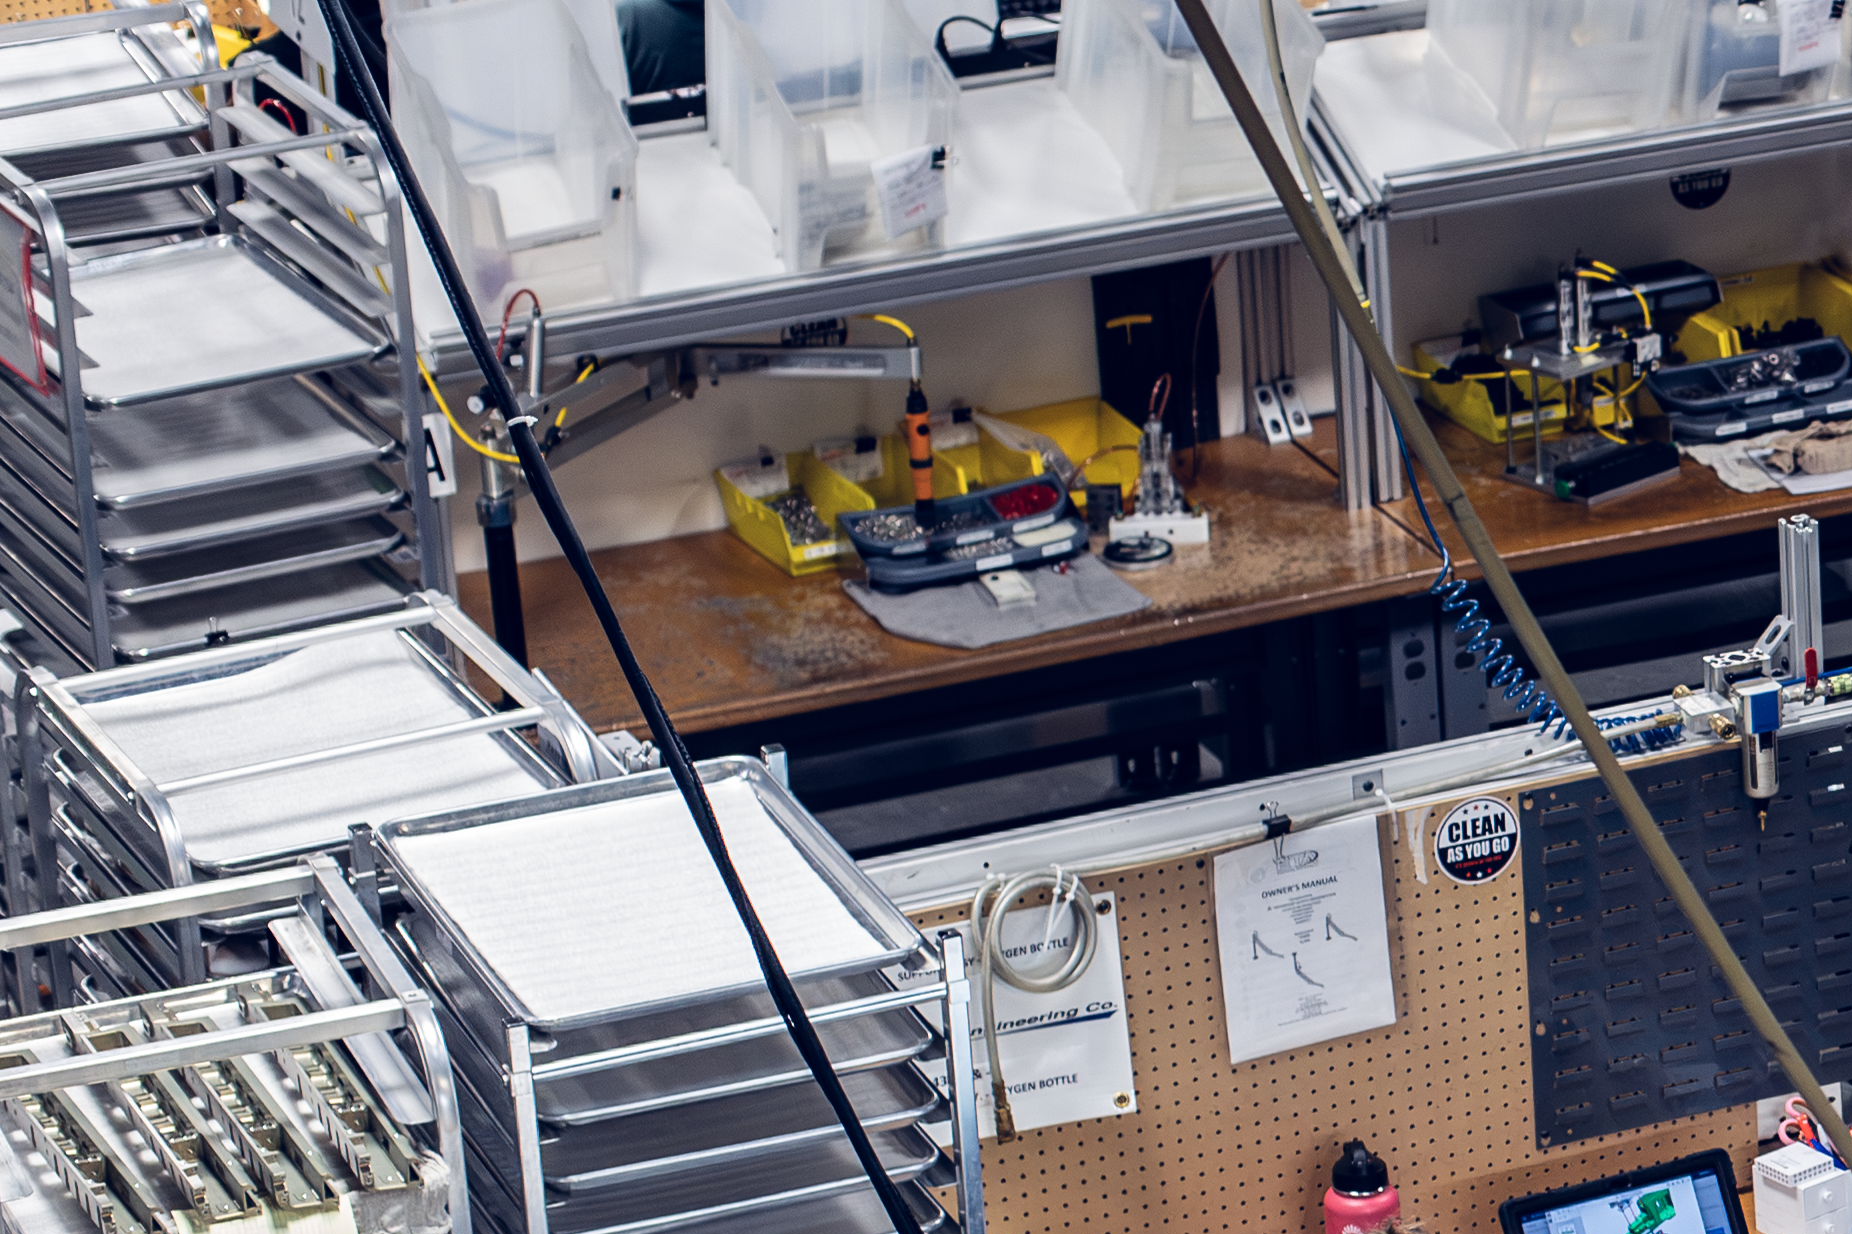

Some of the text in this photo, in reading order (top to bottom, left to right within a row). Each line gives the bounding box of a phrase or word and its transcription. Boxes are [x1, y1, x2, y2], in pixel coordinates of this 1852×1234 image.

[424, 427, 446, 482] A
[1448, 812, 1506, 843] CLEAN
[1447, 846, 1463, 863] AS
[1465, 840, 1490, 859] YOU
[1492, 836, 1510, 853] GO
[1261, 874, 1338, 899] OWNER'S MANUAL
[1030, 937, 1070, 954] BOTLE
[1086, 1000, 1118, 1014] Co.
[1039, 1073, 1079, 1091] BOTTLE
